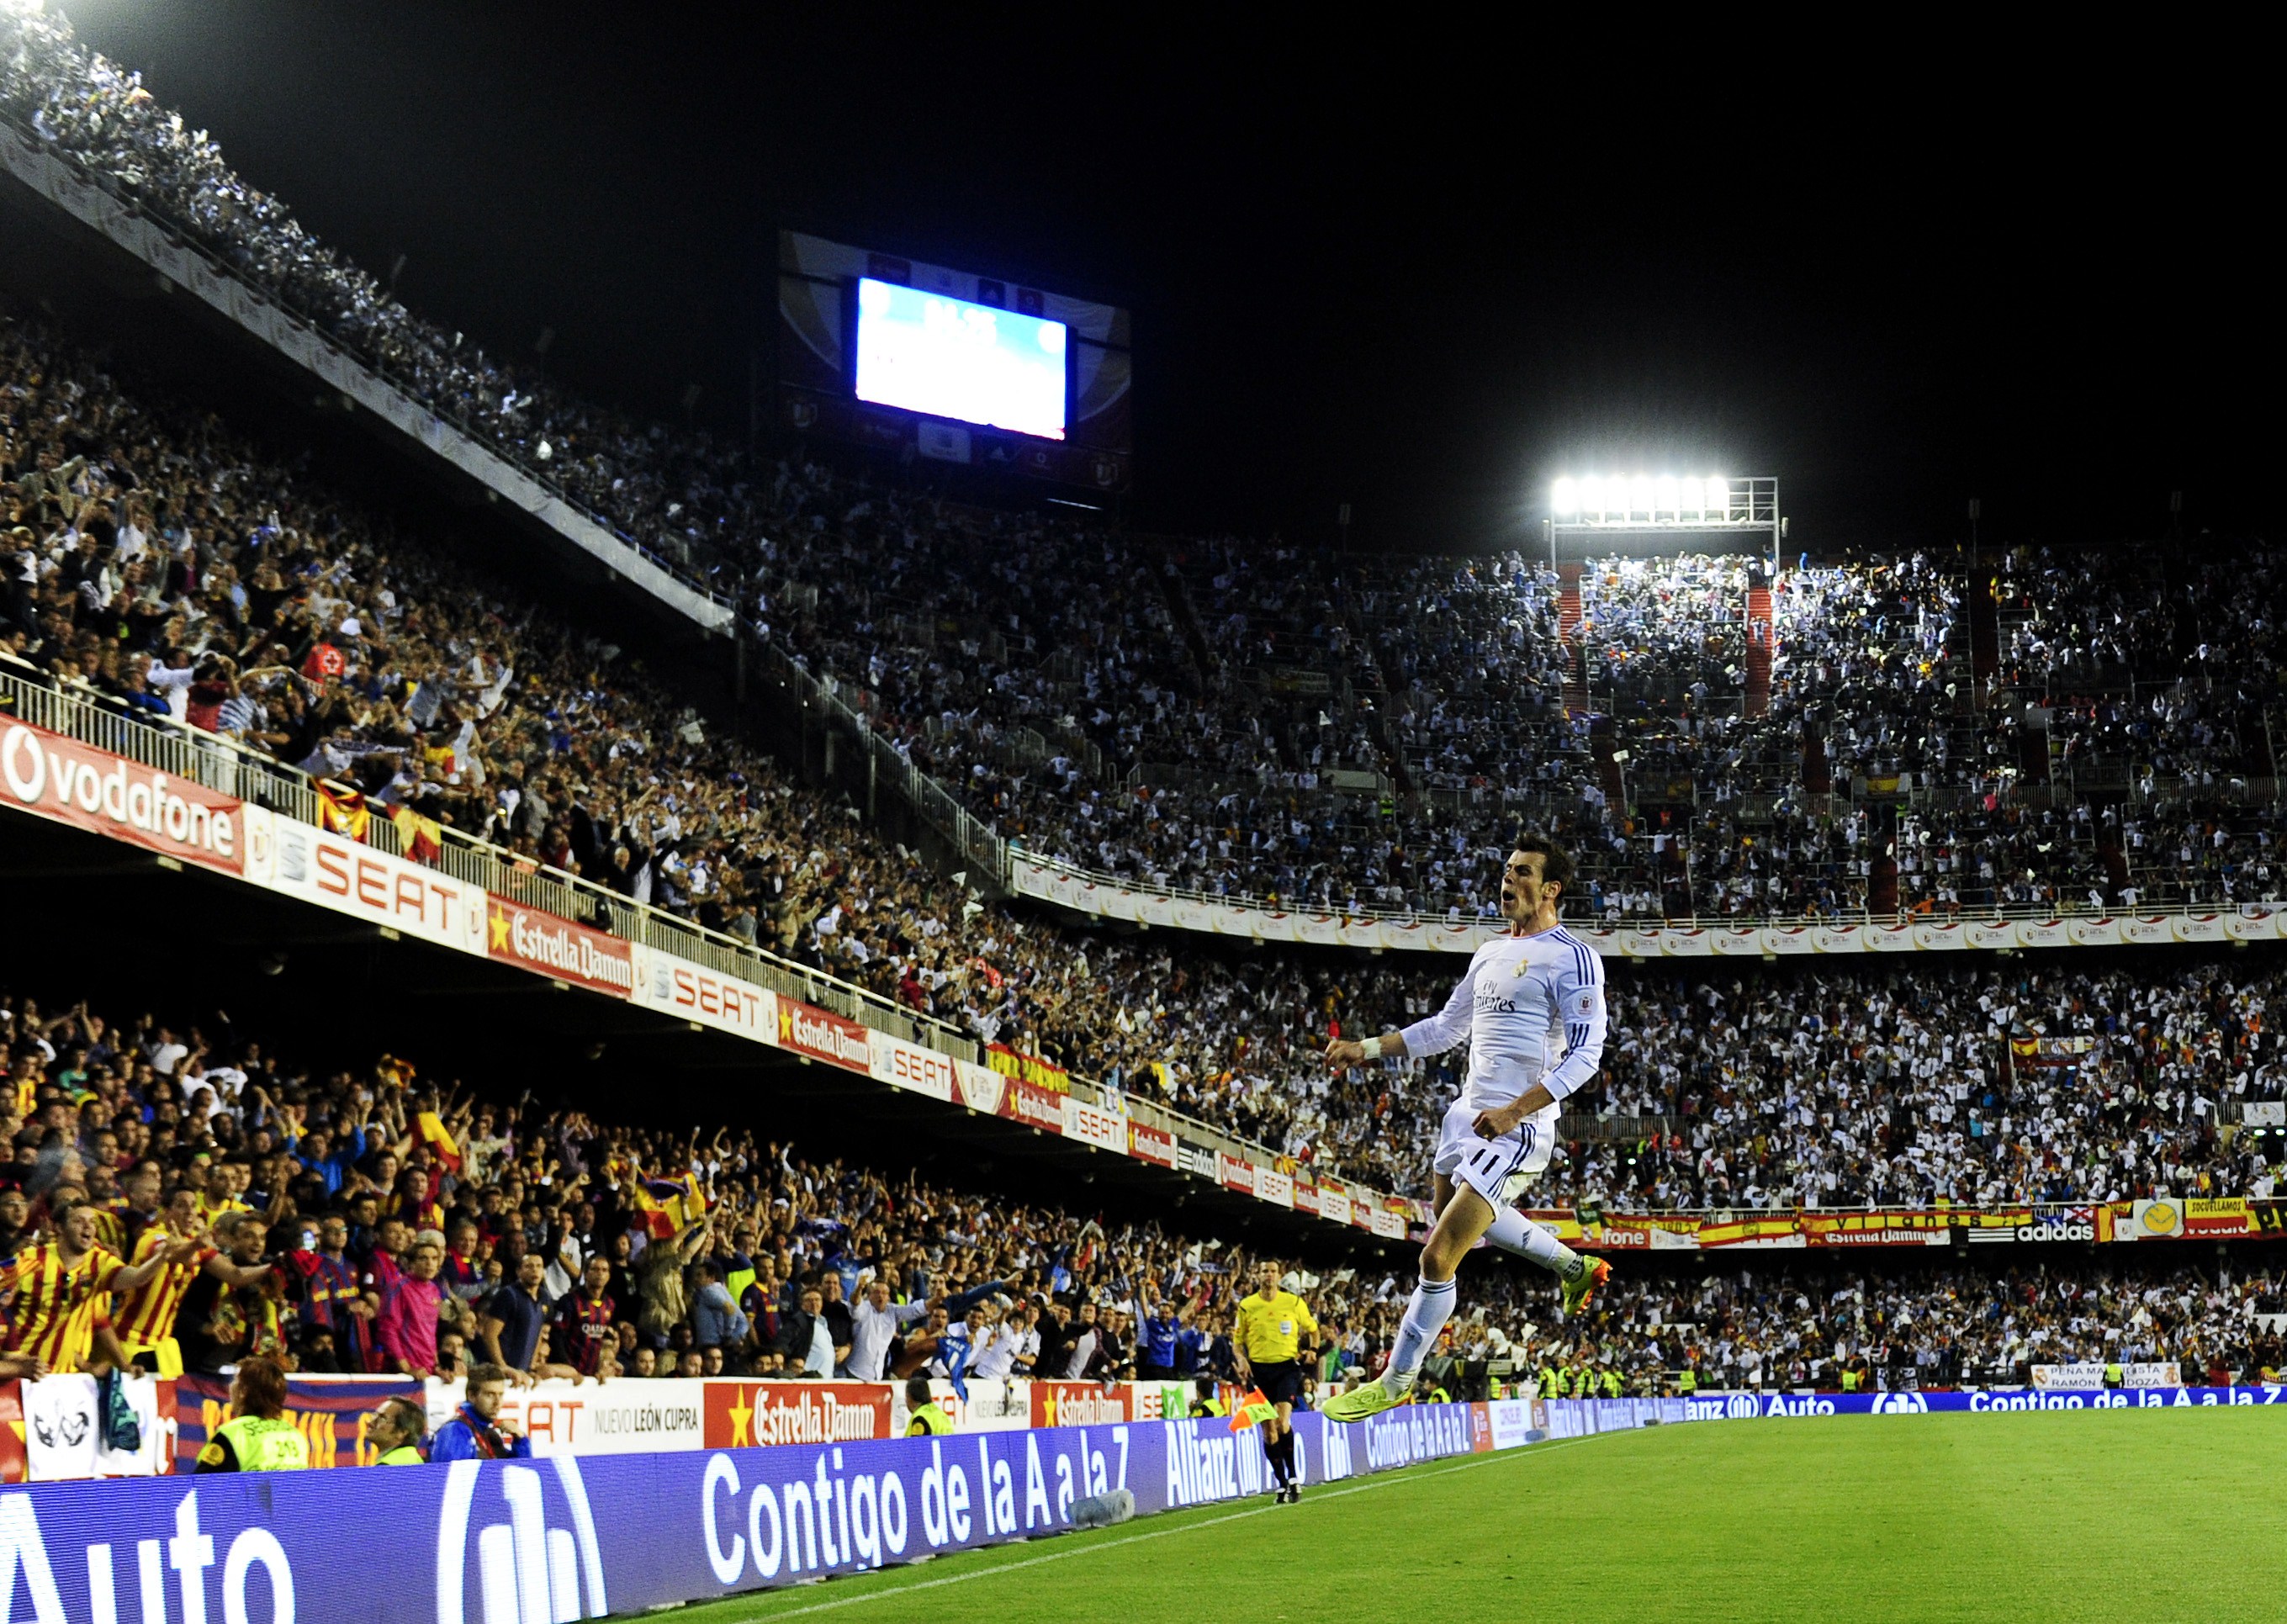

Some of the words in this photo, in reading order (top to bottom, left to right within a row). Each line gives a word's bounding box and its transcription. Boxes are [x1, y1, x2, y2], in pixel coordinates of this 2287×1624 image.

[50, 753, 234, 857] vodafone
[316, 844, 458, 930] SEAT
[512, 911, 580, 972] Estrella
[579, 934, 631, 988] Damm
[675, 971, 759, 1027] SEAT
[793, 1008, 834, 1052] Estrella
[833, 1024, 869, 1065] Damm
[895, 1049, 949, 1090] SEAT
[1079, 1111, 1118, 1140] SEAT
[1469, 1149, 1501, 1176] 11
[2017, 1222, 2094, 1242] adidas
[471, 1401, 584, 1443] EAT
[596, 1407, 632, 1435] NUEVO
[633, 1403, 662, 1432] LEÓN
[664, 1405, 698, 1431] CUPRA
[753, 1386, 822, 1447] Estrella
[821, 1391, 876, 1443] Damm
[1056, 1385, 1093, 1427] Estrella
[1093, 1389, 1124, 1425] Damm
[1767, 1394, 1835, 1417] Auto
[1970, 1392, 2083, 1413] Contigo
[2094, 1389, 2129, 1409] de
[2139, 1389, 2163, 1408] la
[2173, 1388, 2193, 1407] A
[2202, 1392, 2218, 1406] a
[2229, 1387, 2253, 1405] la
[2263, 1387, 2282, 1405] Z
[1166, 1418, 1236, 1509] Allianz
[1364, 1410, 1410, 1468] Contigo
[702, 1448, 908, 1585] Contigo
[920, 1439, 971, 1548] de
[978, 1435, 1017, 1537] la
[1025, 1431, 1052, 1531] A
[1056, 1453, 1075, 1523] a
[1079, 1429, 1109, 1498] la
[0, 1487, 295, 1624] Auto
